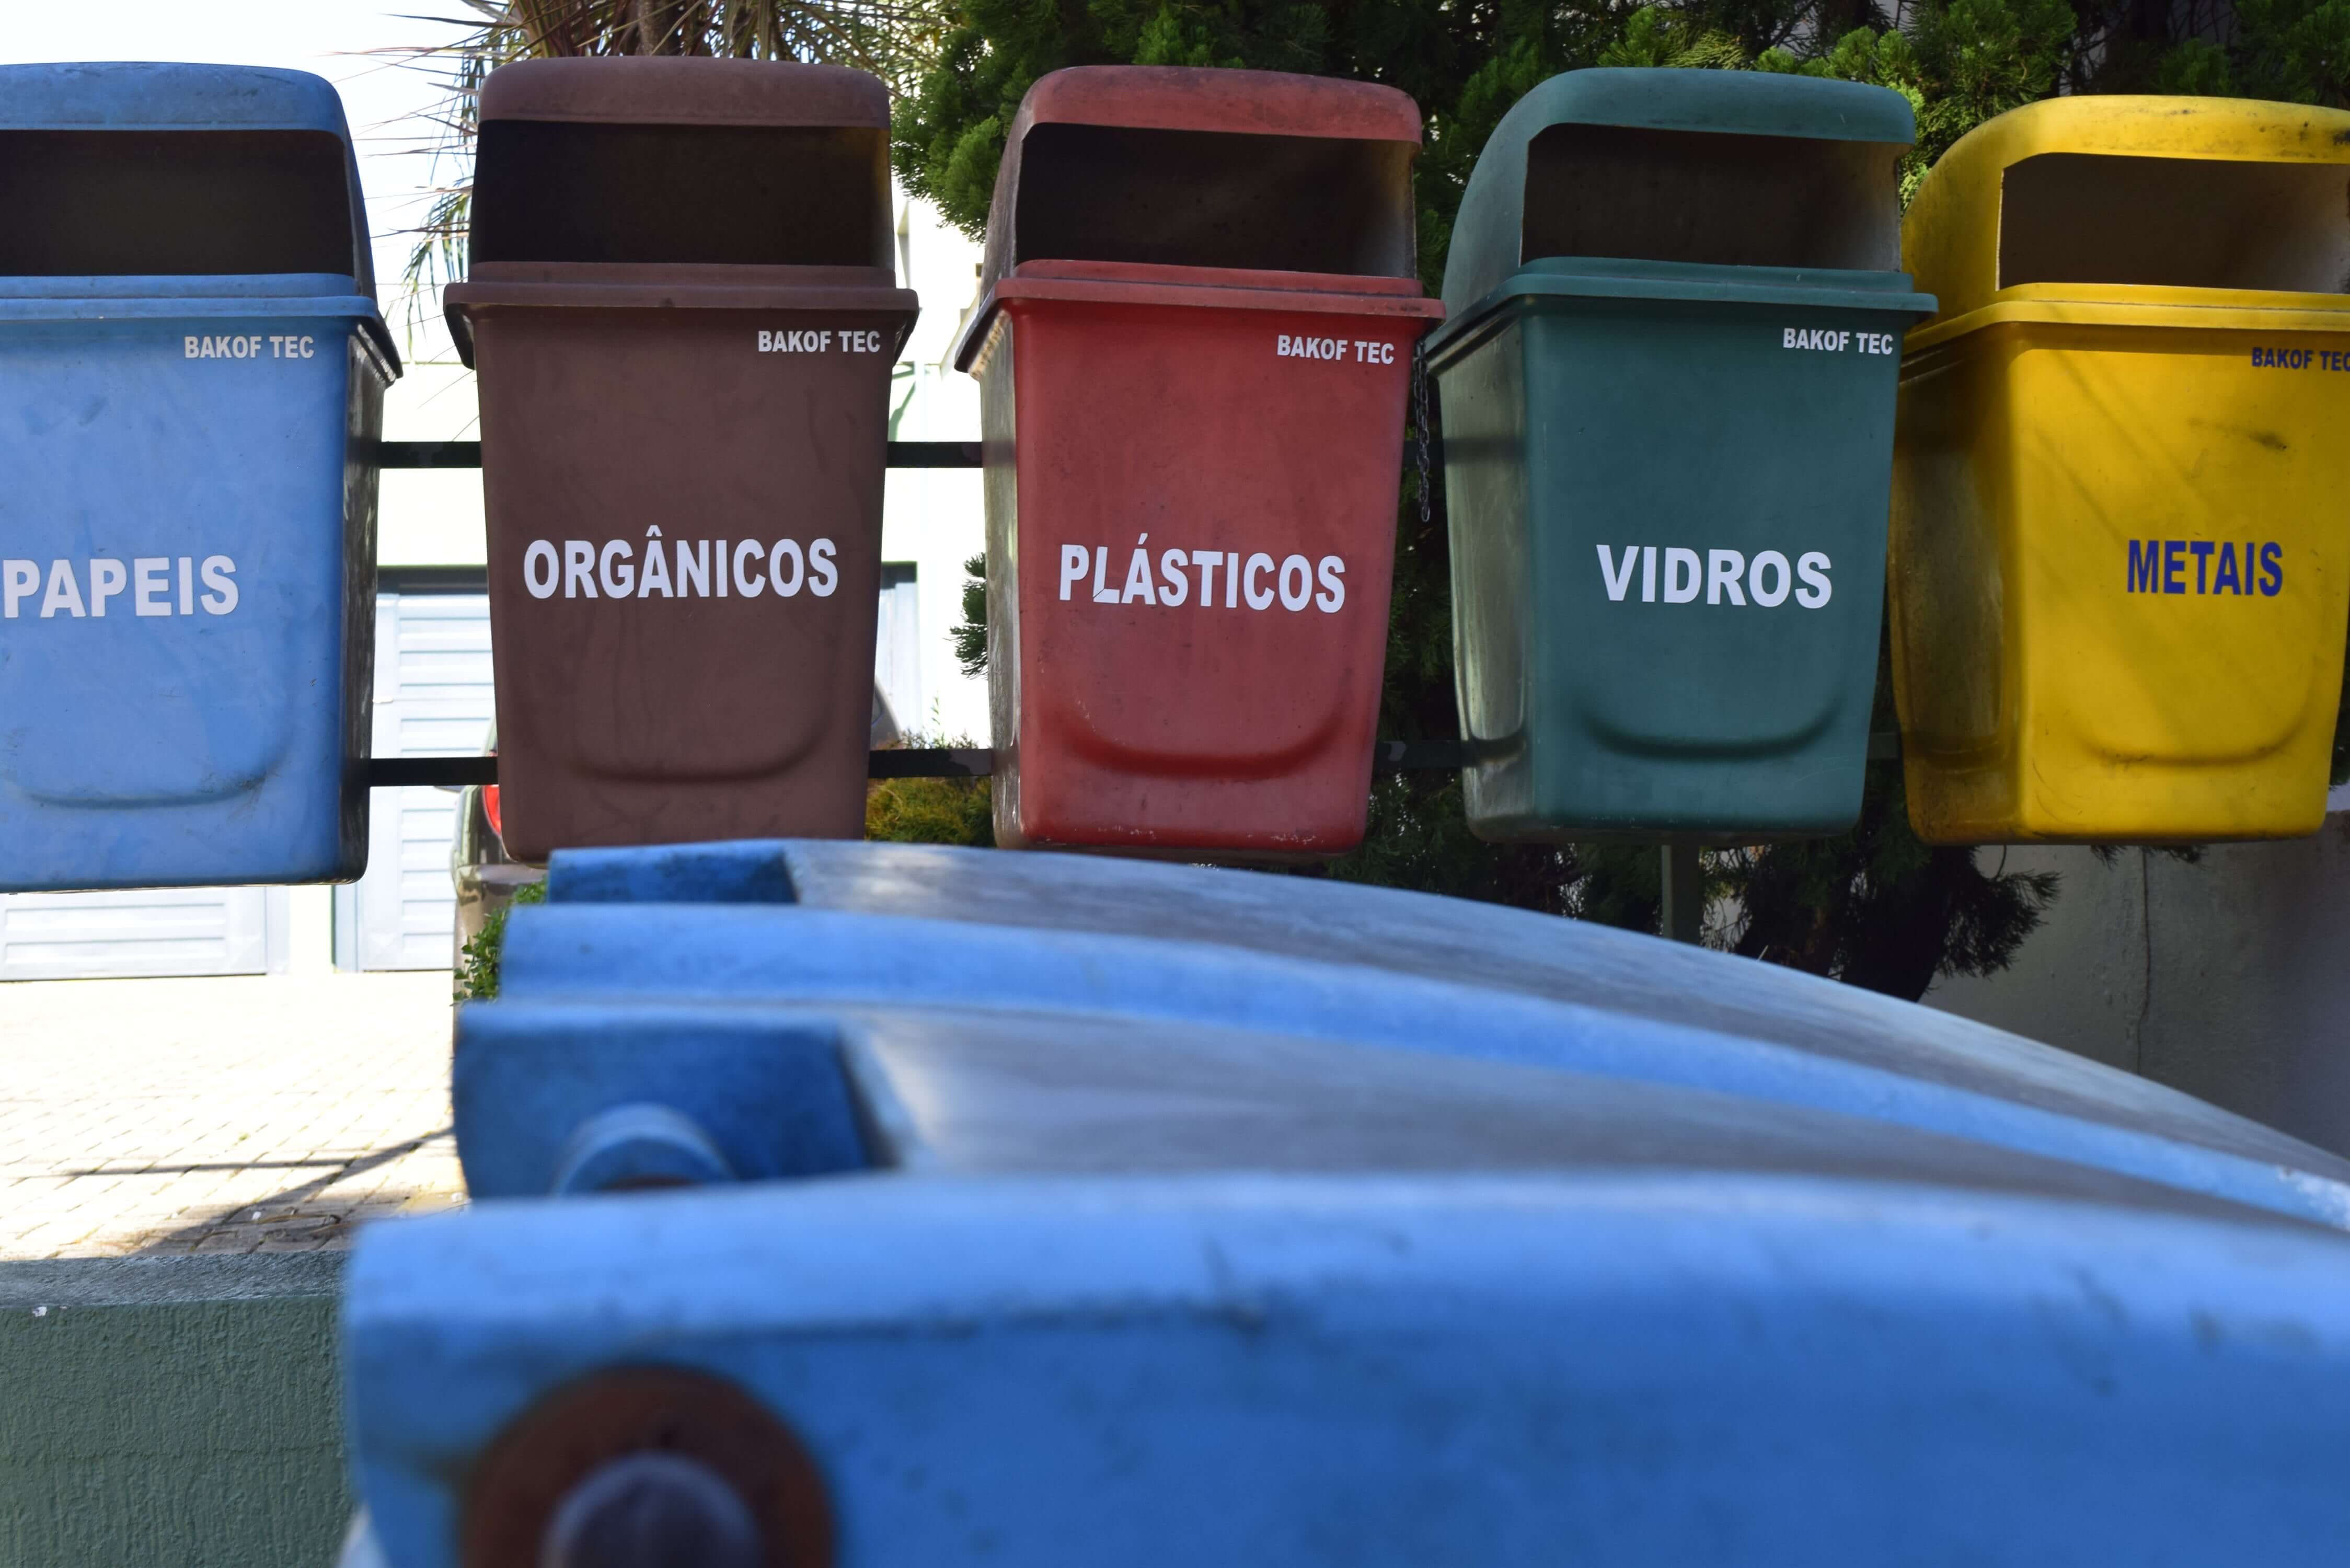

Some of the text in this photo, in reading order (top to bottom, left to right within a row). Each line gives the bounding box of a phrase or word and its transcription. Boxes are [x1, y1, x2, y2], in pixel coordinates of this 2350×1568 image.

[185, 336, 314, 359] BAKOF TEC
[757, 330, 881, 353] BAKOF TEC
[1276, 334, 1395, 365] BAKOF TEC
[1783, 328, 1893, 355] BAKOF TEC
[2251, 347, 2313, 370] BAKOF
[523, 524, 838, 599] ORGÂNICOS
[1058, 532, 1346, 614] PLÁSTICOS
[1596, 544, 1833, 609] VIDROS
[2127, 539, 2284, 597] METAIS
[3, 555, 239, 619] PAPEIS
